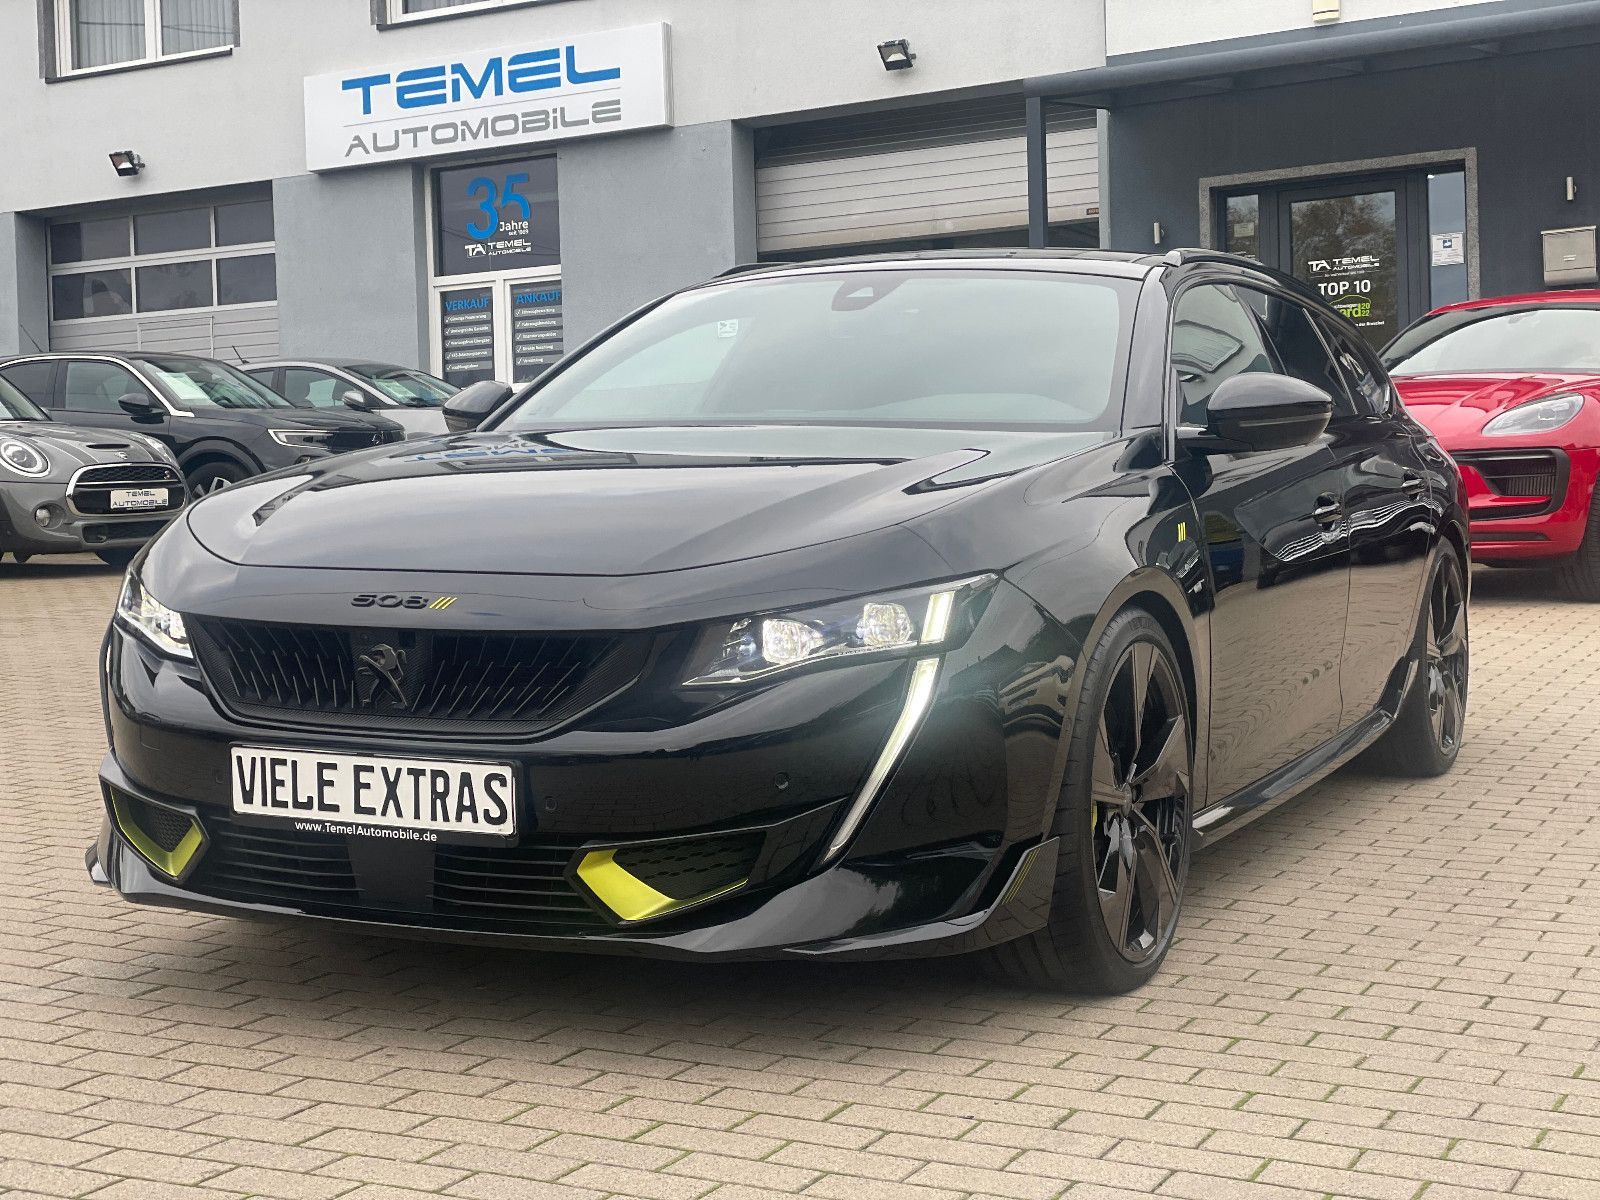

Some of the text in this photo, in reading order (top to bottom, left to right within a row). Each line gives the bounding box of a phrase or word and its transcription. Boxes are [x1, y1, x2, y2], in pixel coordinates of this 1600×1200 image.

[342, 45, 621, 115] TEMEL
[465, 172, 531, 240] 35
[499, 220, 529, 231] Jahre
[487, 239, 532, 249] TEMEL
[1332, 255, 1380, 265] TEMEL
[1318, 279, 1371, 296] TOP 10
[446, 297, 490, 311] VERKAUF
[515, 289, 561, 304] ANKAUF
[350, 594, 429, 610] 508
[235, 754, 508, 826] VIELE EXTRAS
[295, 821, 438, 842] www.TemelAutomobile.de
